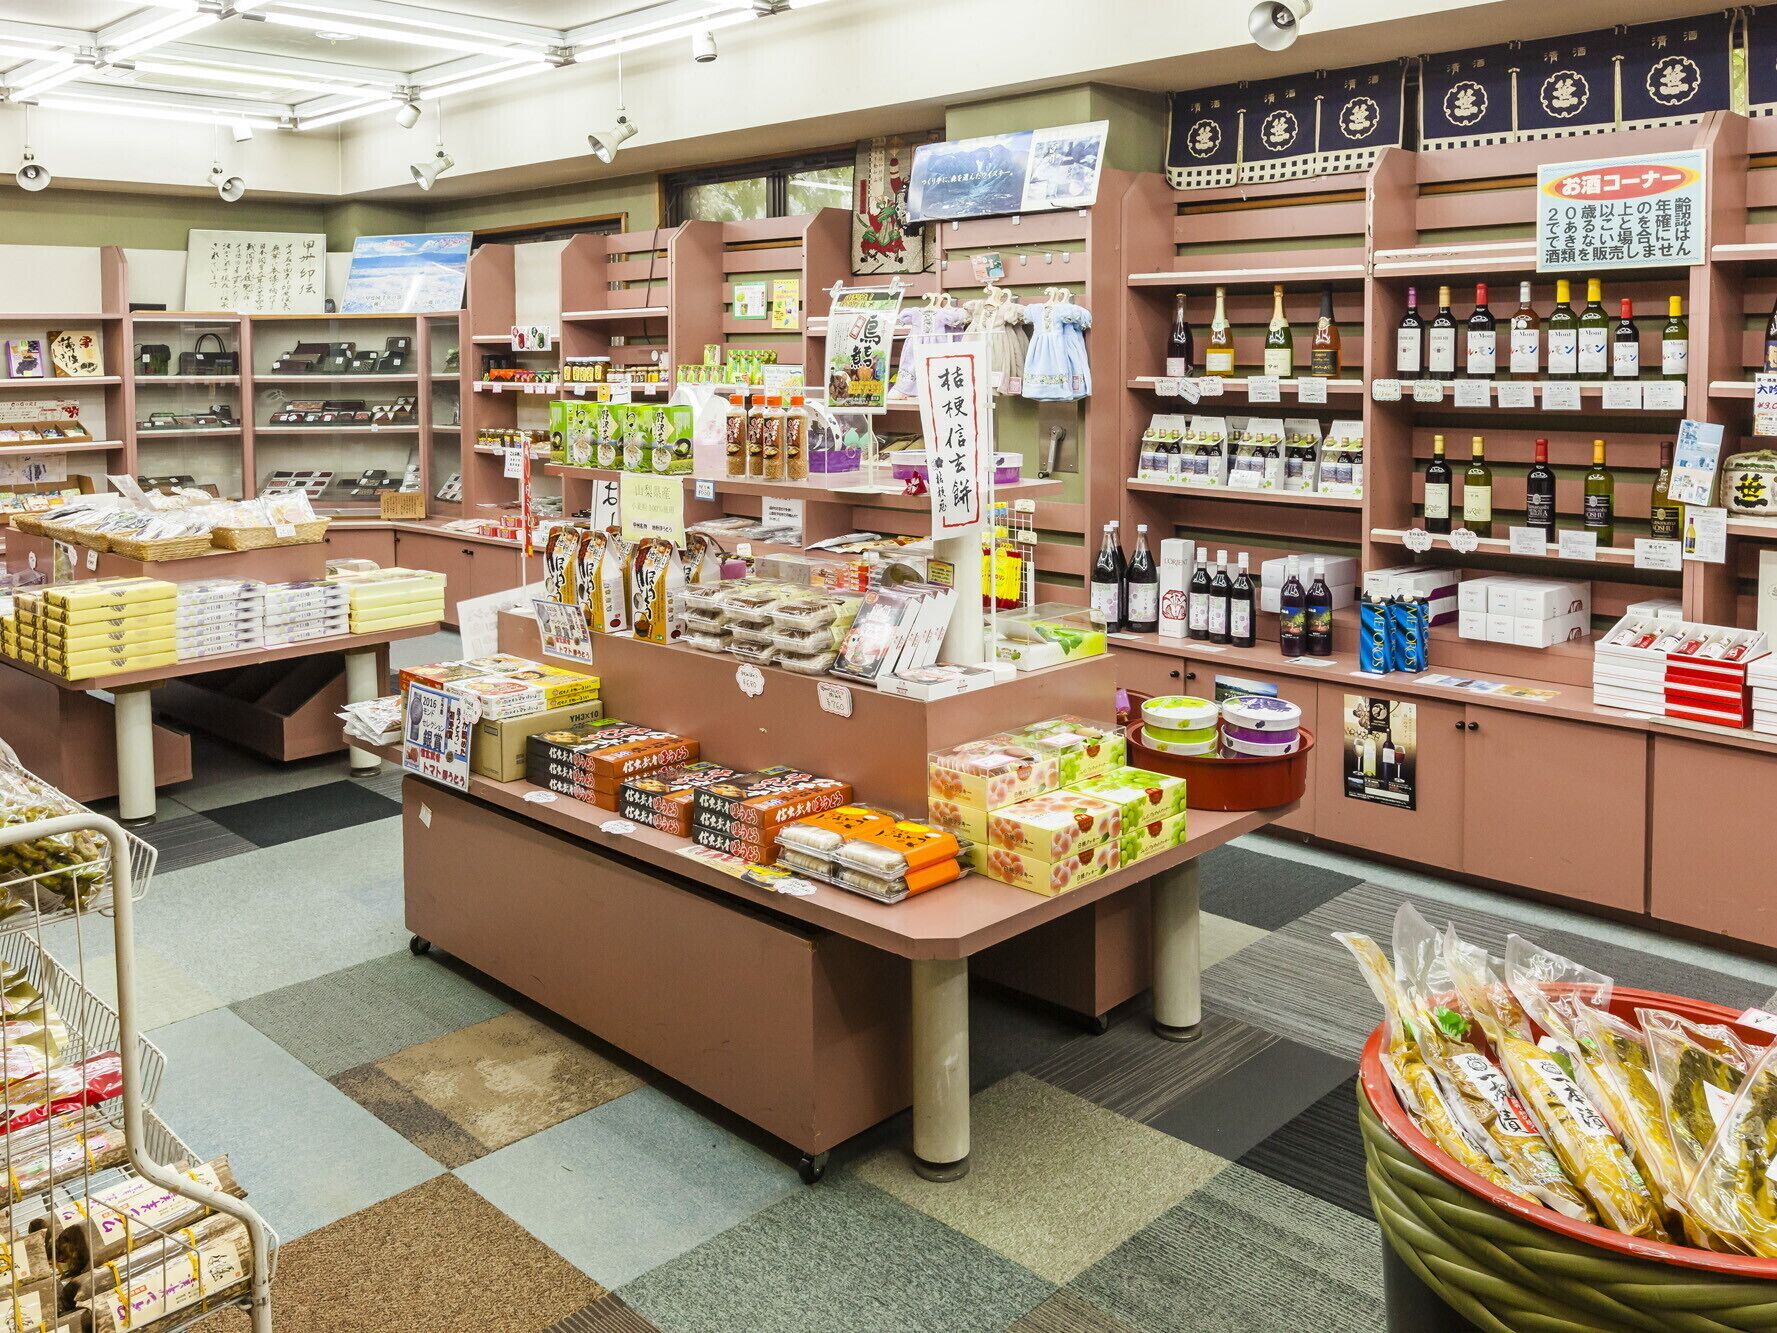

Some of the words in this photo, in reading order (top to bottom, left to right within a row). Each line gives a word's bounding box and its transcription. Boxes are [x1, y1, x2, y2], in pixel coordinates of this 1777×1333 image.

[1561, 170, 1682, 196] お酒コーナー
[1546, 211, 1692, 235] であることを確認
[1545, 228, 1692, 249] できない場合には
[1545, 242, 1692, 264] 酒類を販売しません
[938, 365, 972, 513] 桔梗信玄餅
[422, 696, 438, 709] 2016
[422, 720, 446, 732] セレクション
[423, 729, 443, 751] 銀賞
